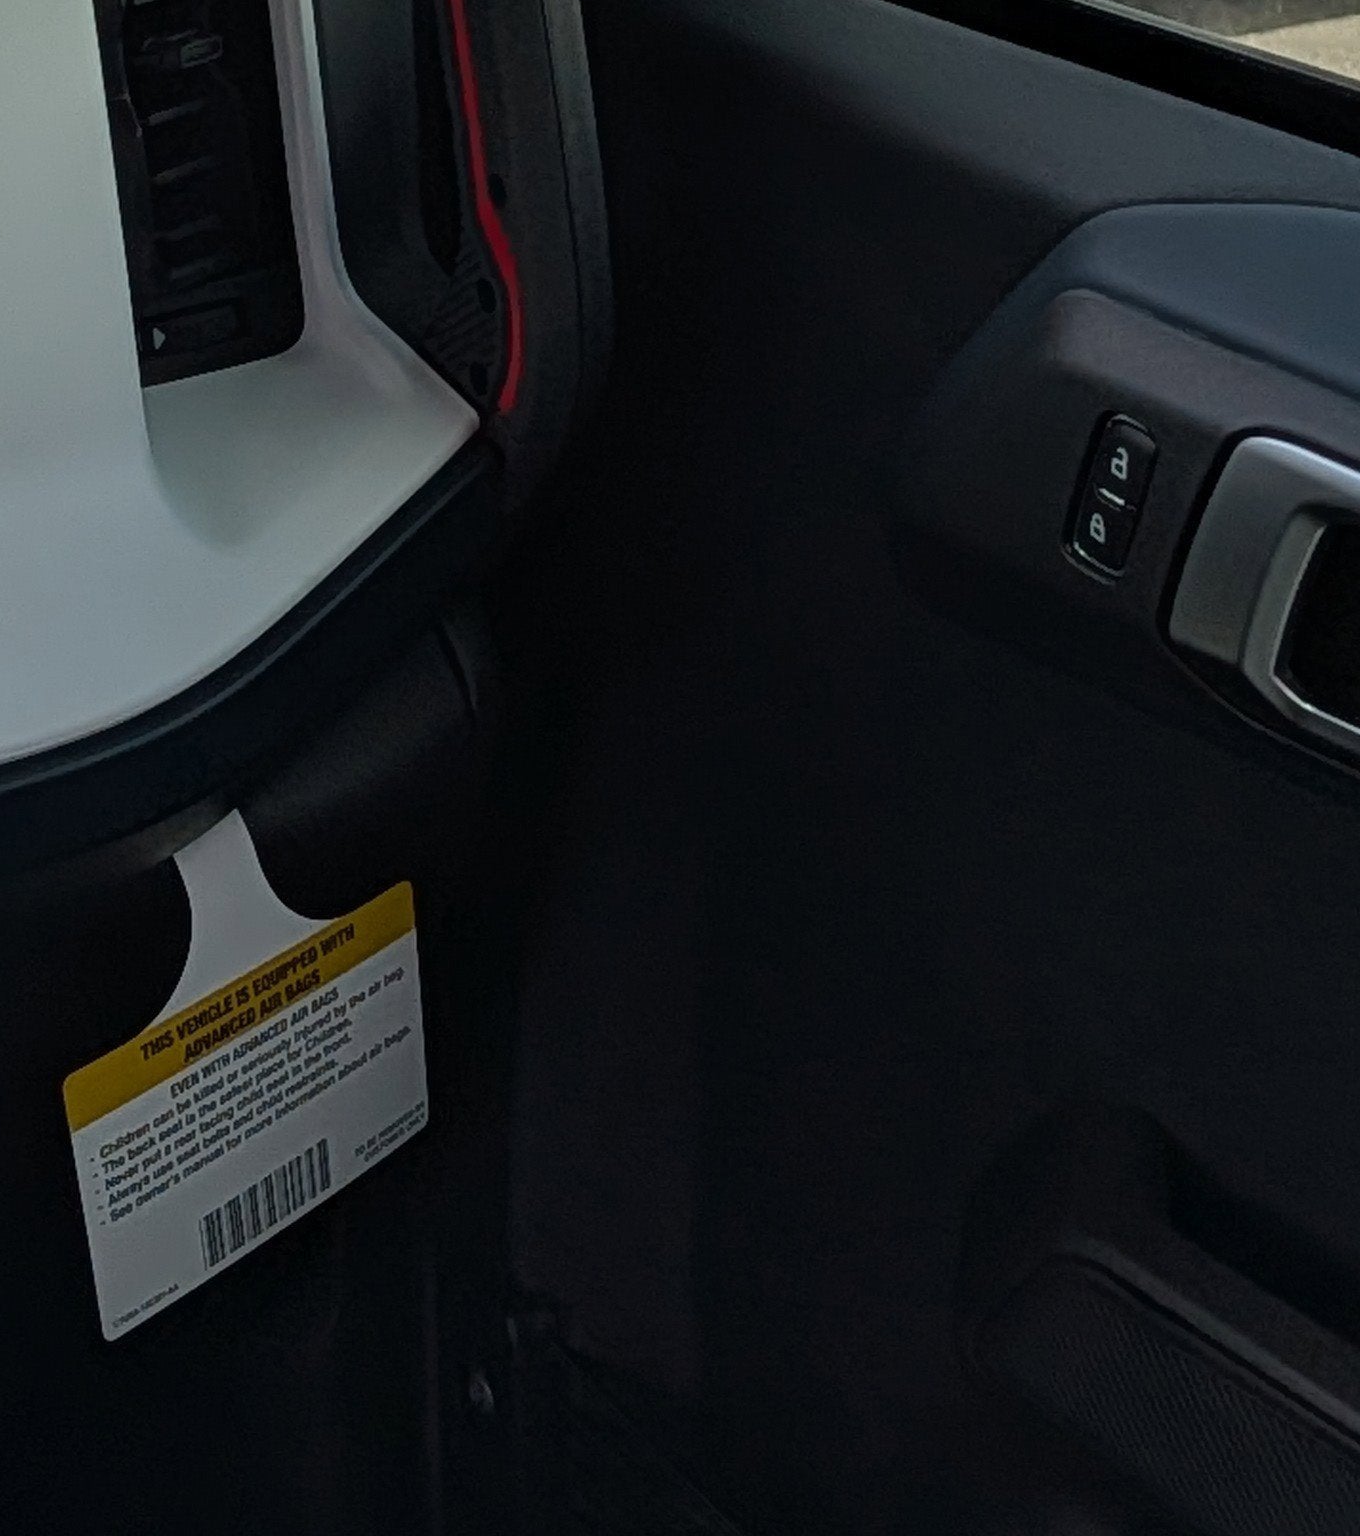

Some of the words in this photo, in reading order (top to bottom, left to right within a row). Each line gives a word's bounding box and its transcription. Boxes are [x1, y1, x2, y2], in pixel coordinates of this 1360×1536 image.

[140, 1029, 174, 1061] THIS
[175, 994, 233, 1041] VEHICLE
[235, 985, 249, 1006] IS
[252, 945, 317, 996] EQUIPPED
[319, 923, 354, 956] WITH
[170, 1071, 199, 1096] EVEN
[200, 1053, 230, 1078] WITH
[232, 1018, 288, 1059] ADVANCED
[289, 1006, 308, 1025] AIR
[310, 987, 339, 1012] BAGS
[182, 1006, 256, 1062] ADVANCED
[258, 990, 282, 1017] AIR
[284, 967, 320, 1002] BAGS
